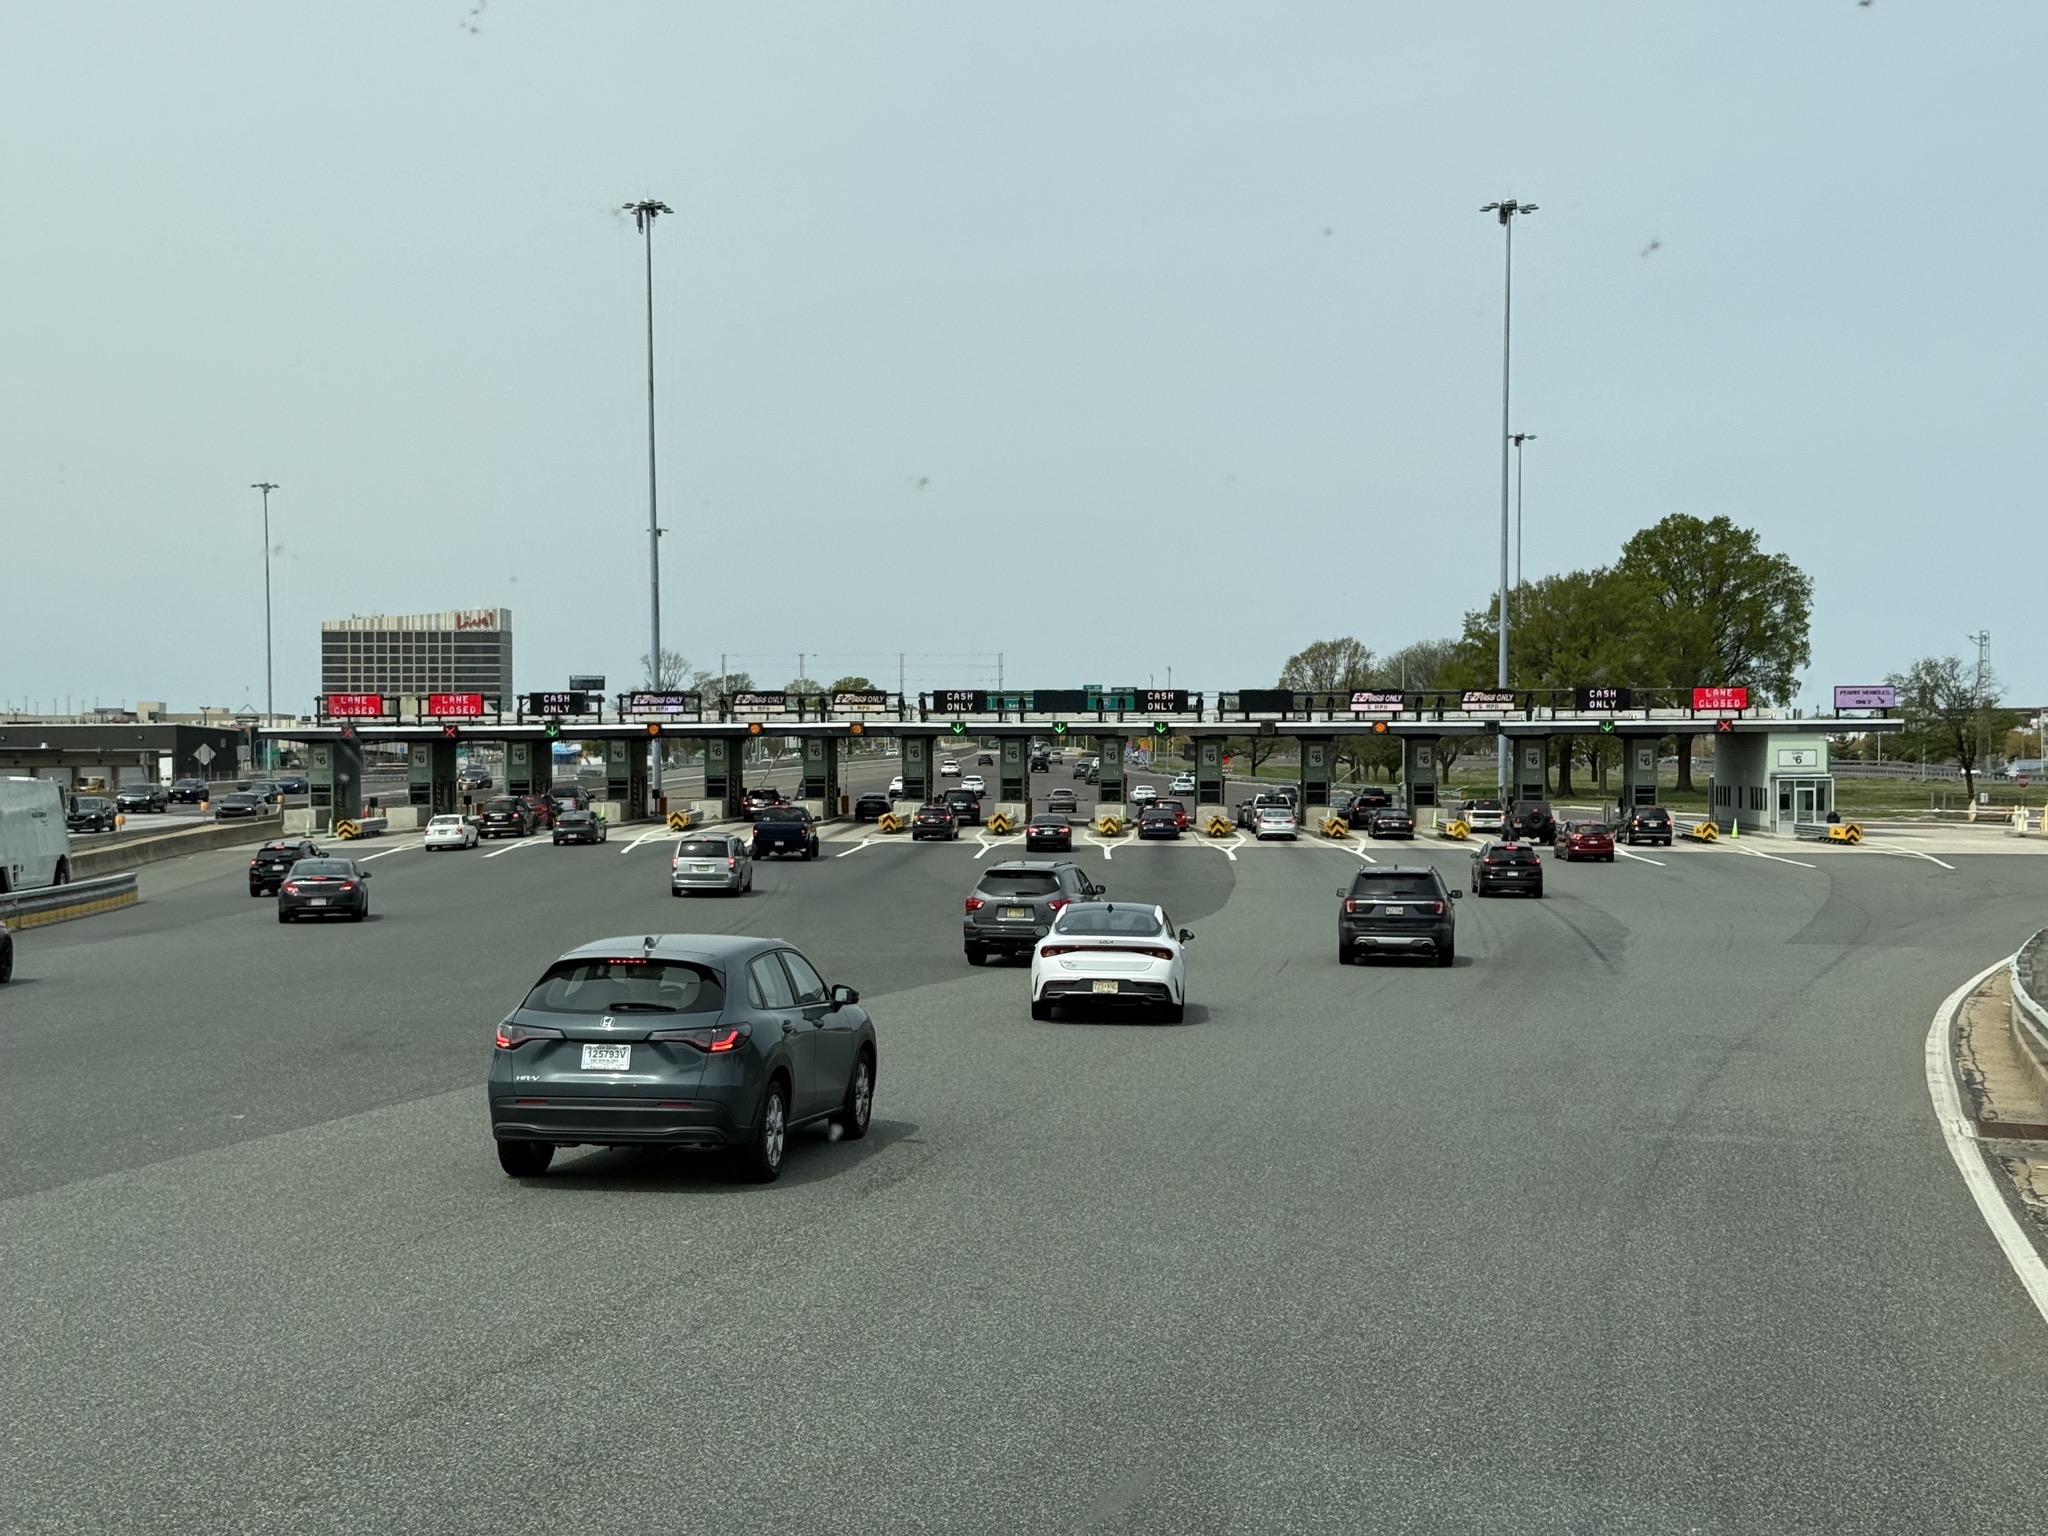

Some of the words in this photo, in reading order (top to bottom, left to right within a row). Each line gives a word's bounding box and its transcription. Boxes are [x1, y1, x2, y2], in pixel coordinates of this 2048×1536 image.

[946, 692, 974, 701] CASH
[1147, 692, 1174, 700] CASH
[1589, 689, 1617, 698] CASH
[1705, 688, 1734, 697] LANE
[340, 696, 367, 705] LANE
[441, 696, 469, 704] LANE
[543, 694, 571, 702] CASH
[665, 696, 684, 704] ONLY
[767, 695, 785, 704] ONLY
[867, 695, 885, 704] ONLY
[1385, 694, 1404, 703] ONLY
[1496, 693, 1515, 702] ONLY
[946, 702, 974, 711] ONLY
[1147, 702, 1174, 711] ONLY
[1589, 700, 1617, 709] ONLY
[1698, 699, 1741, 708] CLOSED
[334, 706, 375, 715] CLOSED
[435, 706, 477, 715] CLOSED
[543, 704, 571, 713] ONLY
[514, 752, 525, 760] $6
[613, 750, 624, 758] $6
[712, 747, 722, 756] $6
[810, 748, 821, 756] $6
[909, 749, 919, 758] $6
[1007, 750, 1018, 759] $6
[1106, 751, 1116, 760] $6
[315, 756, 326, 765] $6
[414, 754, 425, 763] $6
[1205, 753, 1215, 762] $6
[1311, 754, 1321, 763] $6
[1419, 755, 1429, 764] $6
[1528, 756, 1538, 765] $6
[1640, 757, 1650, 766] $6
[1792, 755, 1803, 764] $6
[588, 1050, 627, 1058] 125793V
